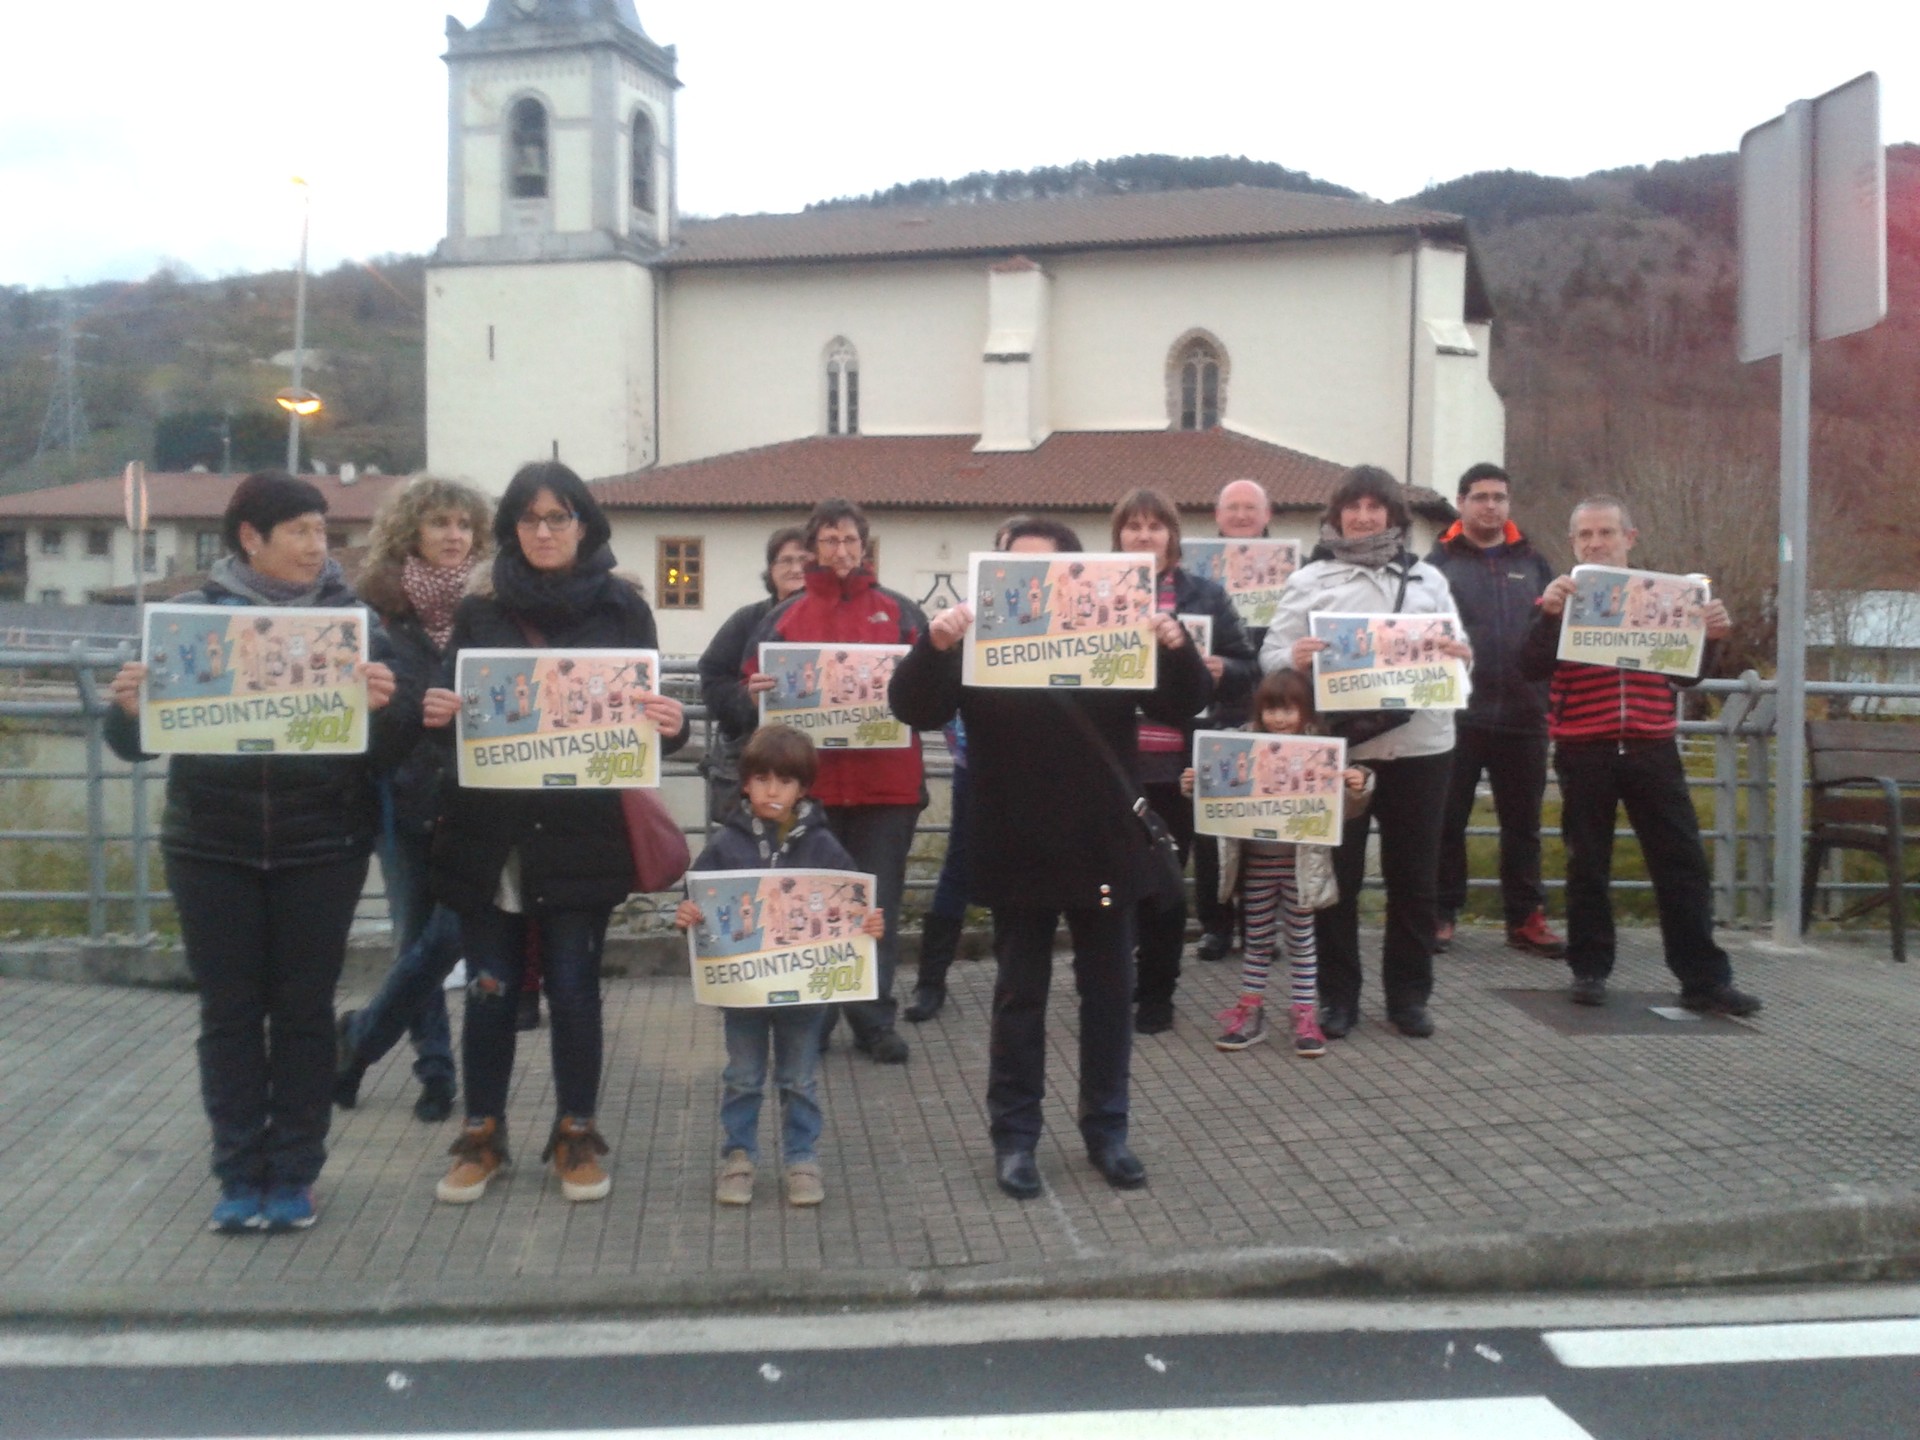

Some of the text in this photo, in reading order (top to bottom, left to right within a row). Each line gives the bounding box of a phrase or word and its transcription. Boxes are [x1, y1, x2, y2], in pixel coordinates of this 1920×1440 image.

[986, 630, 1142, 667] BERDINTASUNA
[1572, 631, 1689, 647] BERDINTASUNA
[1327, 666, 1449, 694] BERDINTASUNA
[160, 691, 346, 730] BERDINTASUNA
[285, 704, 355, 751] #ja!
[474, 727, 640, 767] BERDINTASUNA
[585, 742, 647, 785] #ja!
[1205, 798, 1327, 819] BERDINTASUNA
[704, 942, 857, 985] BERDINTASUNA
[807, 955, 866, 1000] #ja!
